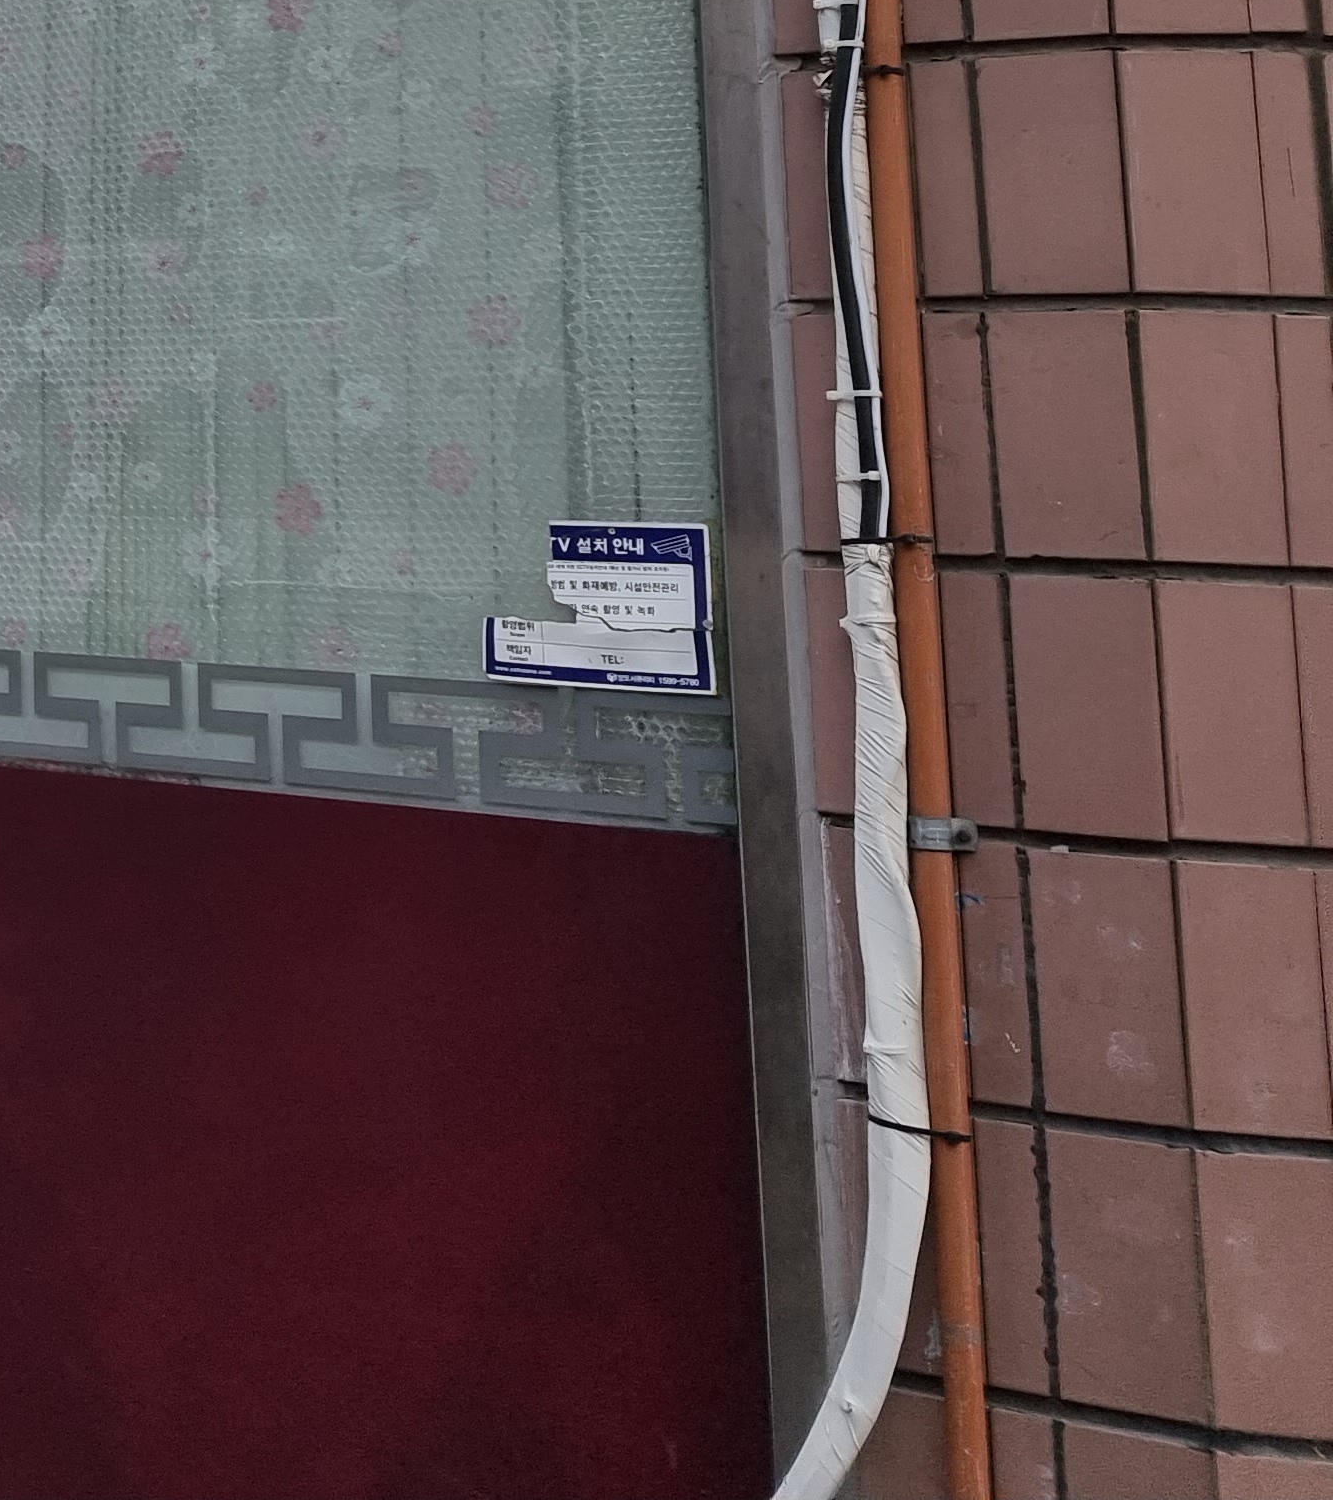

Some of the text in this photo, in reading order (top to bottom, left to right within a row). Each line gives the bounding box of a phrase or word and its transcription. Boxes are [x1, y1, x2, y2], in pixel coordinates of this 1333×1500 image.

[576, 537, 608, 555] 설치
[612, 537, 645, 555] 안내
[624, 581, 679, 594] 시설안전관리
[637, 606, 656, 617] 녹화
